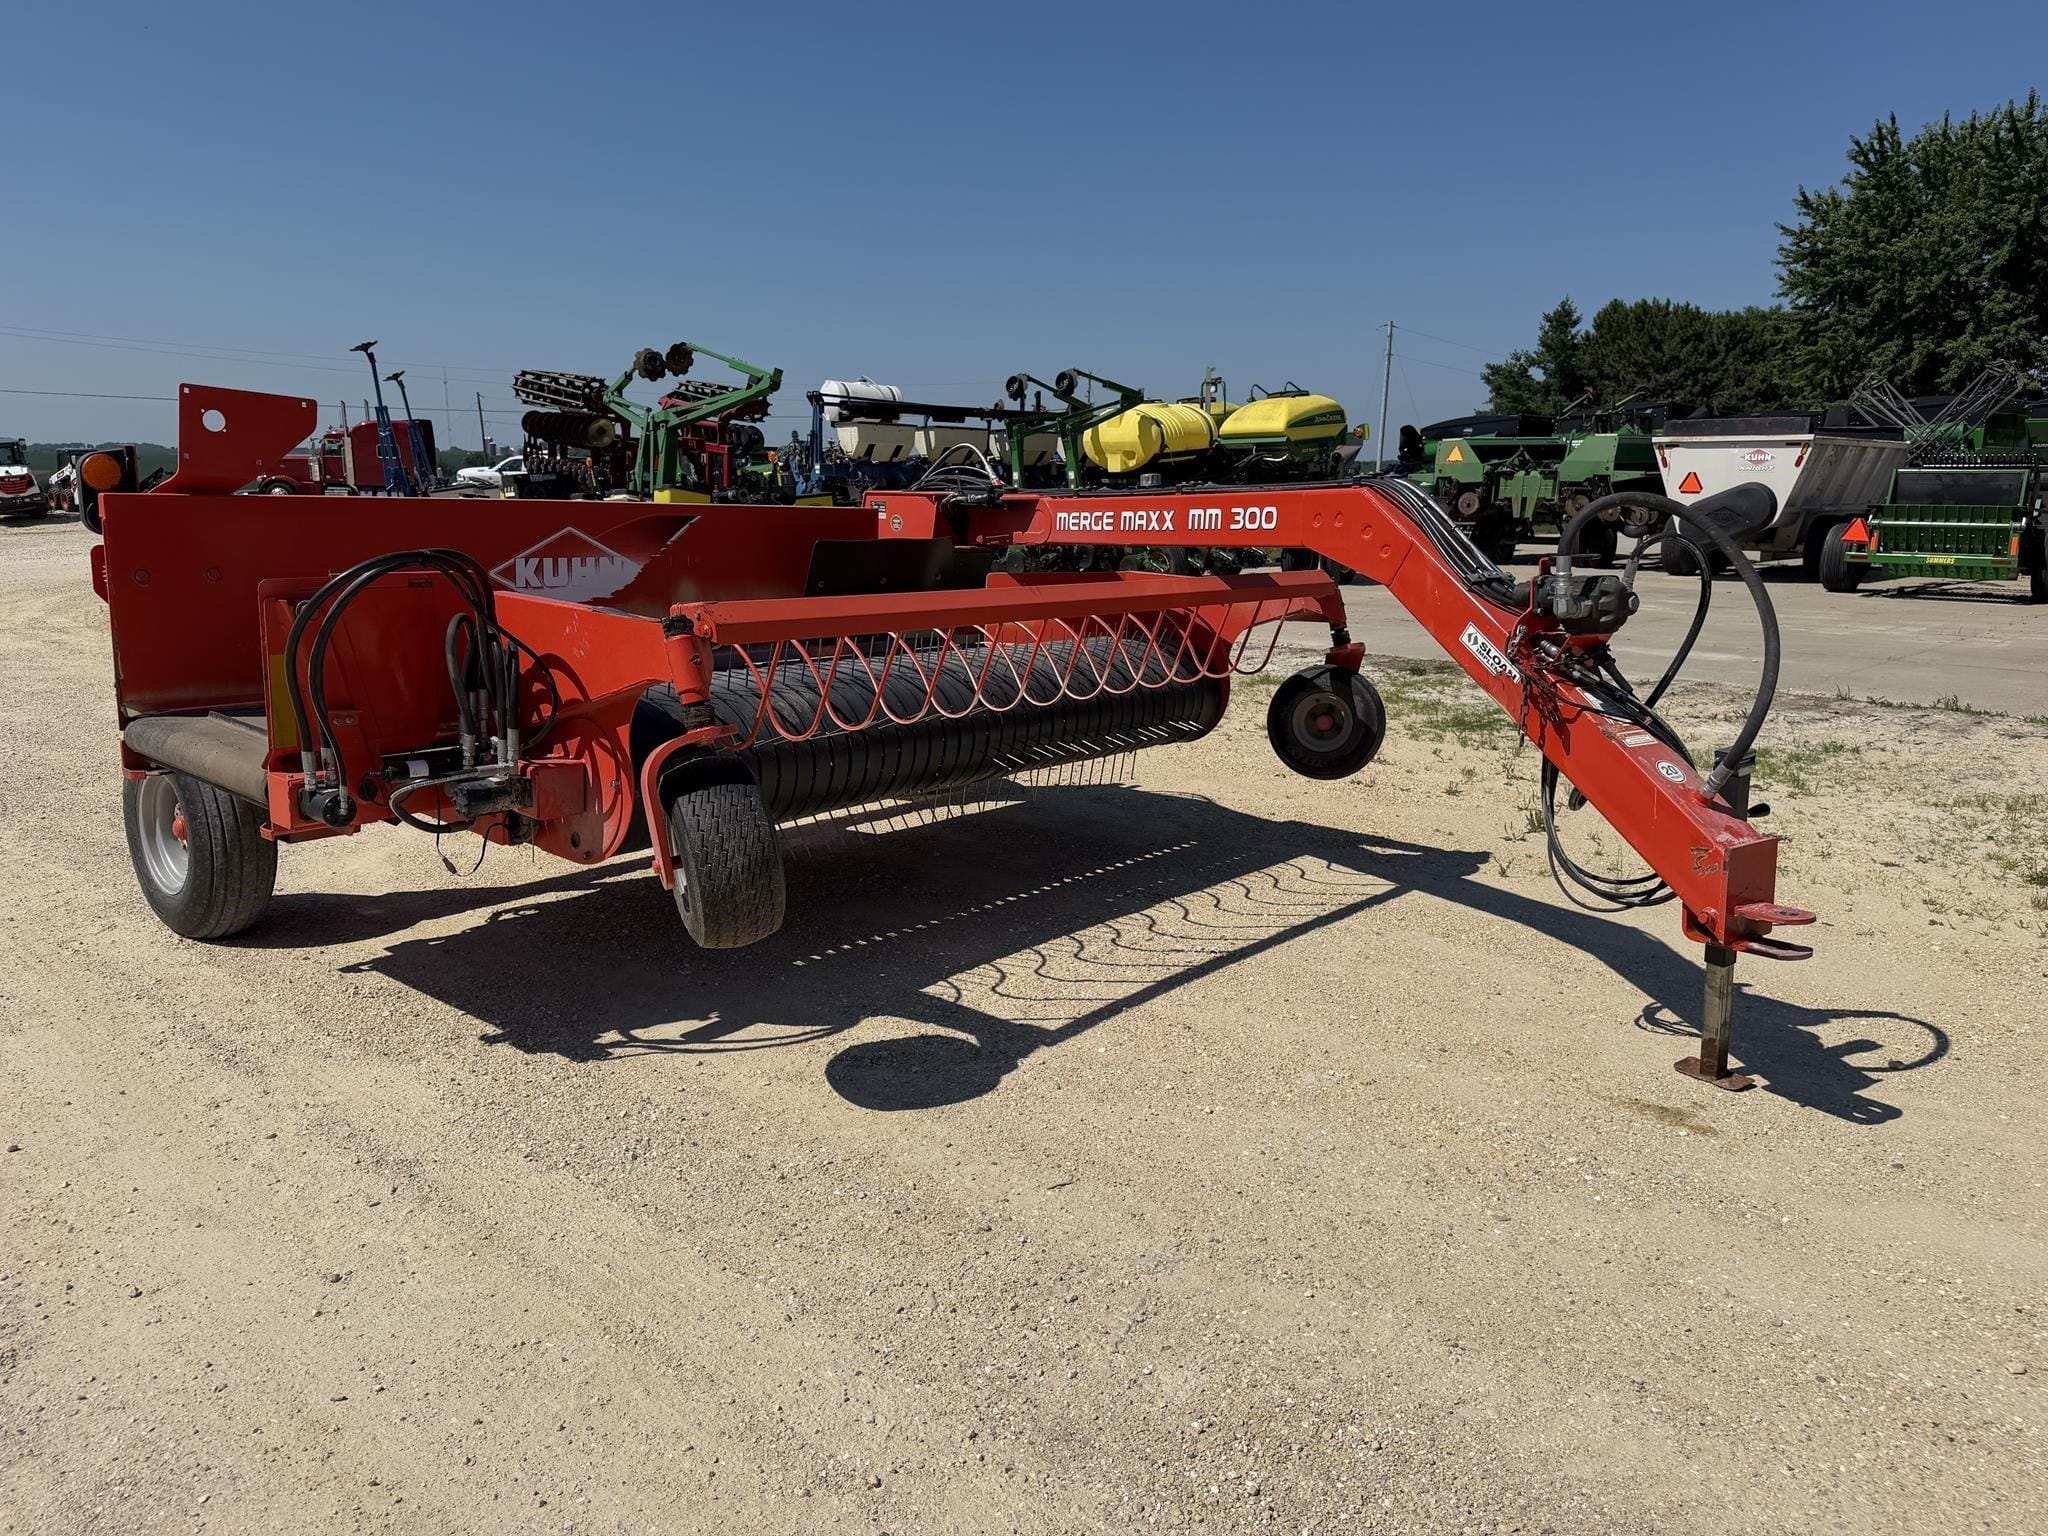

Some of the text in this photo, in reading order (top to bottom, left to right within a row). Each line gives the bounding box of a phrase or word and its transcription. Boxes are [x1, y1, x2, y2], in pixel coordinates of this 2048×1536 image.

[1744, 453, 1772, 461] KUHN
[1056, 506, 1278, 531] MERGE MAXX MM 300
[1926, 557, 1955, 565] SUMMERS
[514, 556, 624, 588] KUHN
[1479, 641, 1517, 680] SLOAN
[1661, 765, 1678, 776] 20
